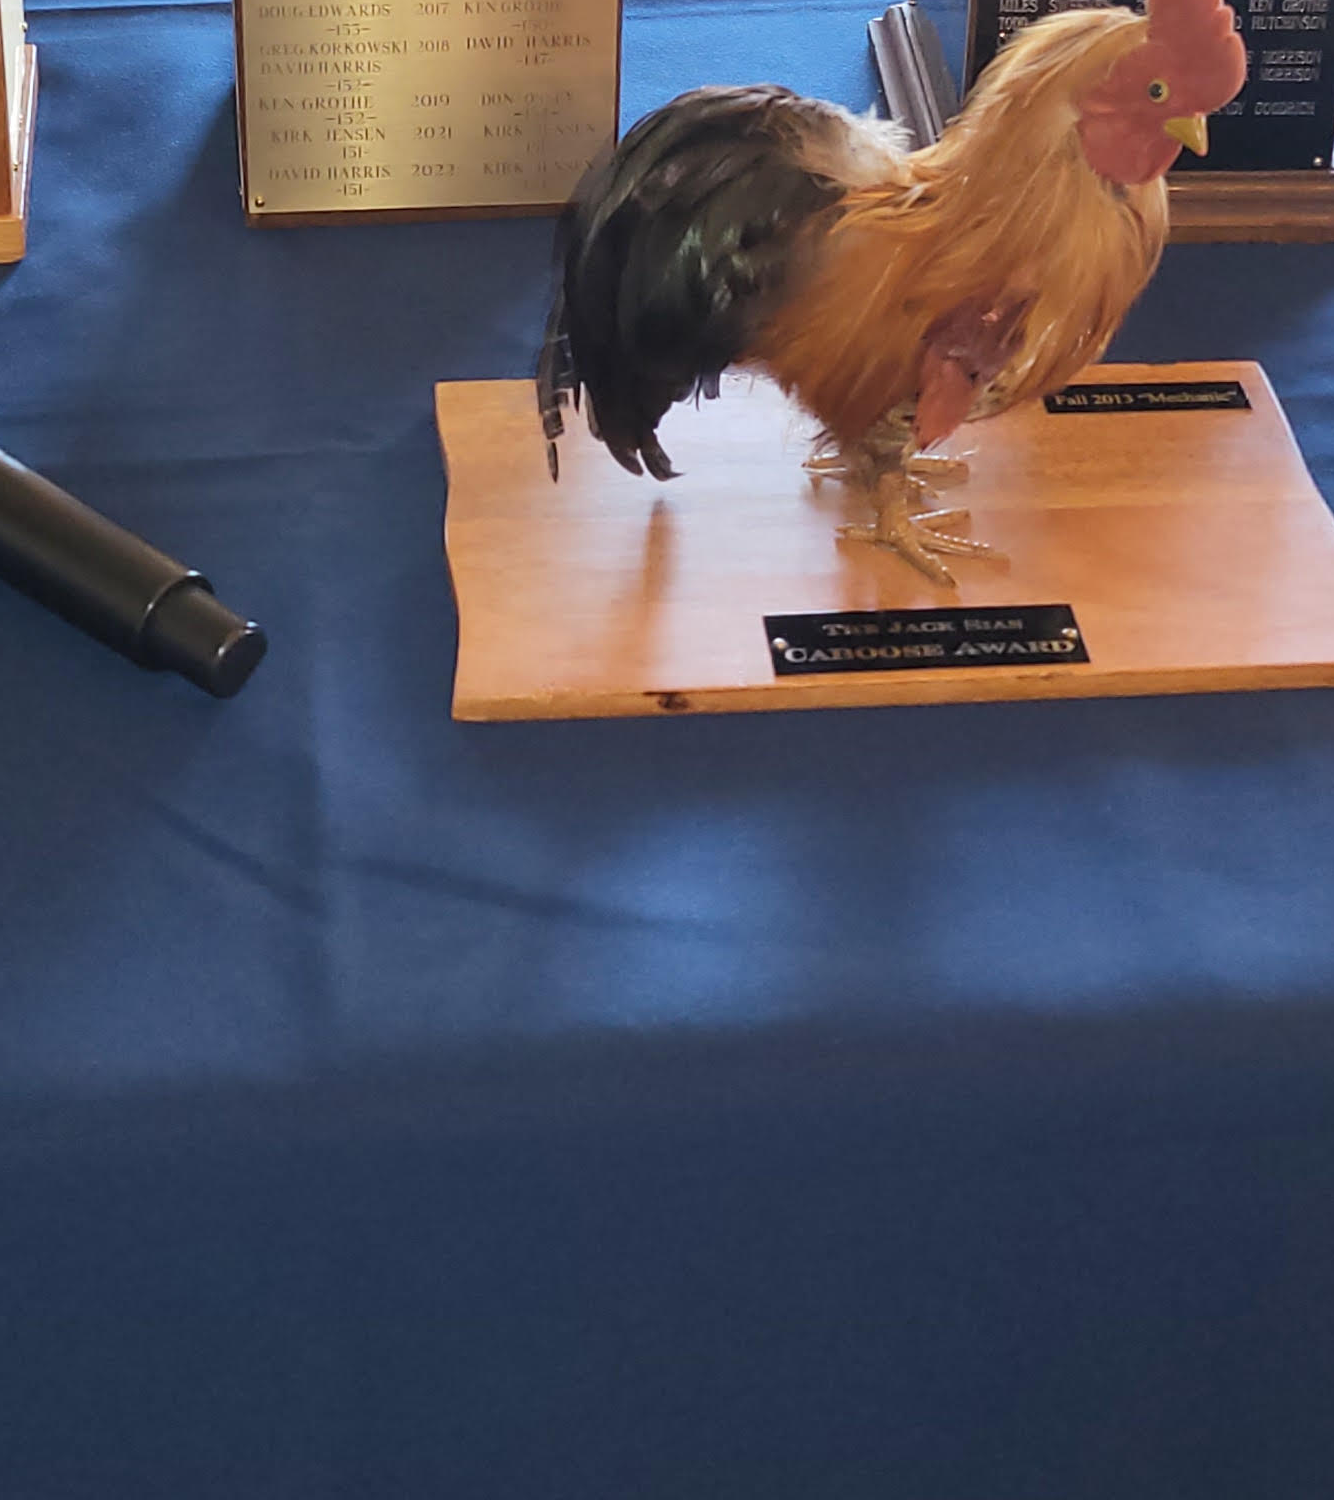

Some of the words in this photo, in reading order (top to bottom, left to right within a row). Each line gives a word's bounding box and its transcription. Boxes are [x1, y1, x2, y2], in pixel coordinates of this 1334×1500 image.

[258, 4, 304, 19] DOUG
[308, 3, 392, 18] EDWARDS
[418, 2, 451, 16] 2017
[464, 2, 496, 15] KEN
[259, 43, 304, 57] GREG
[309, 41, 408, 56] KORKOWSKI
[418, 40, 451, 54] 2018
[466, 36, 515, 51] DAVID
[524, 34, 592, 50] HARRIS
[261, 61, 315, 76] DAVID
[319, 60, 382, 75] HARRIS
[258, 97, 294, 111] KEN
[302, 96, 373, 110] GROTHE
[411, 94, 451, 109] 2019
[271, 129, 313, 144] KIRK
[326, 127, 387, 142] JENSEN
[413, 126, 452, 141] 2021
[483, 124, 523, 139] KIRK
[268, 167, 320, 182] DAVID
[327, 164, 392, 180] HARRIS
[411, 162, 455, 179] 2022
[483, 160, 524, 177] KIRK
[1054, 394, 1088, 406] Fall
[1092, 393, 1134, 406] 2013
[954, 641, 1075, 656] AWARD
